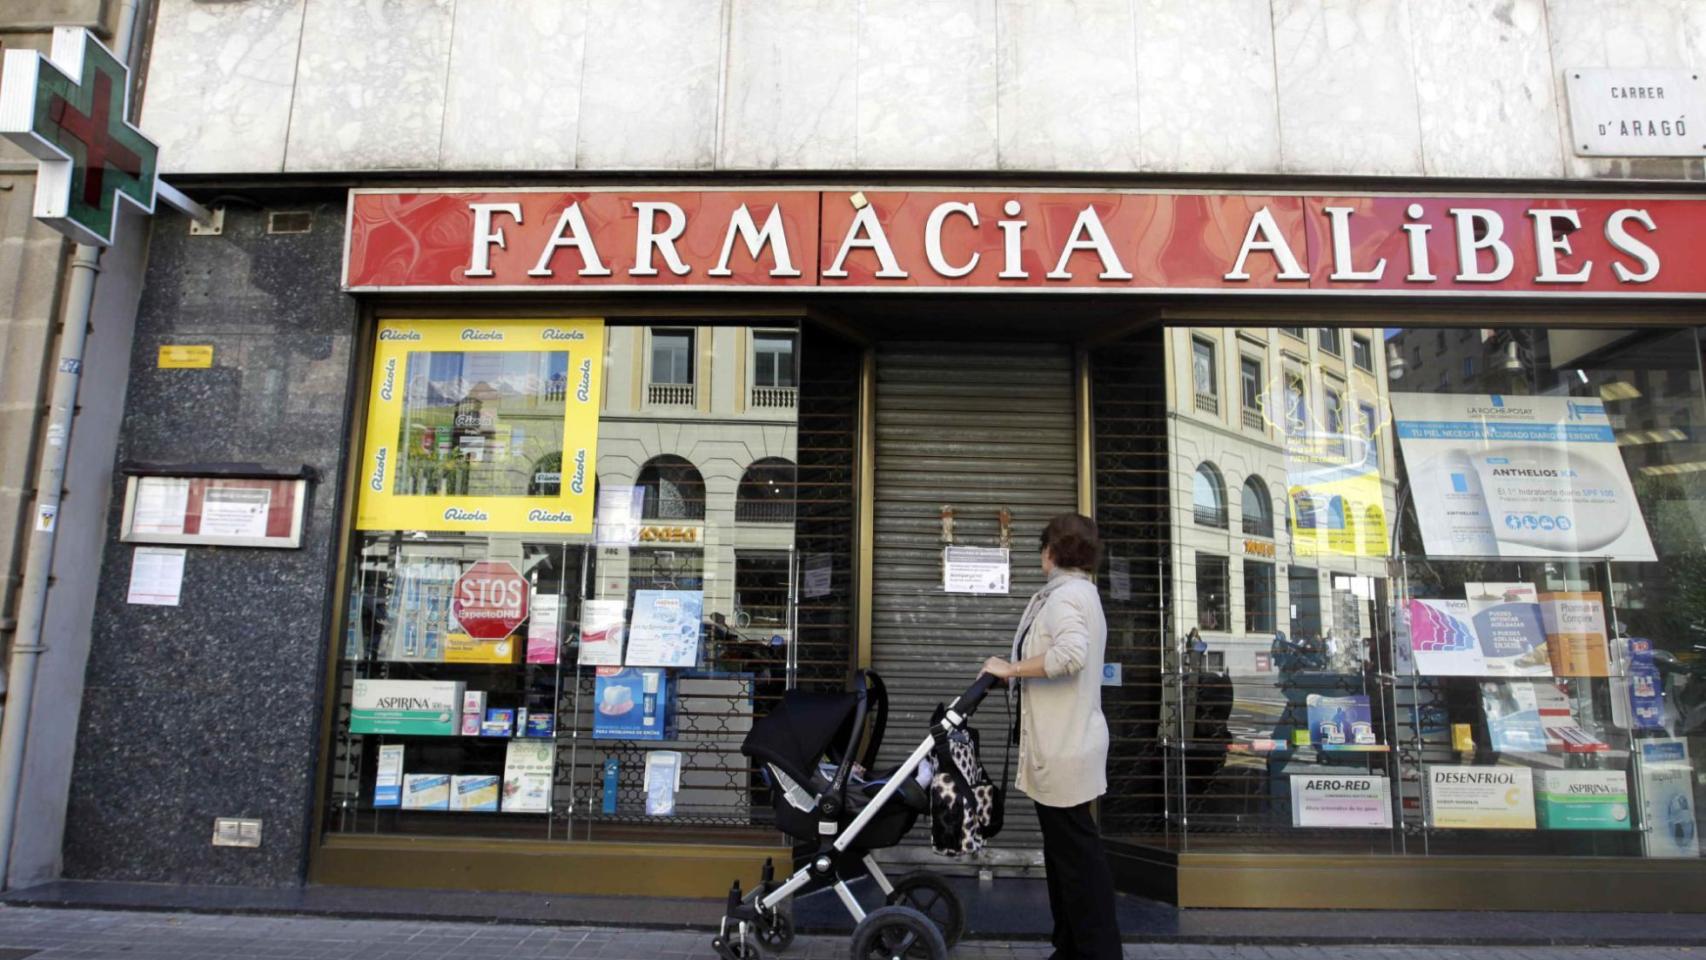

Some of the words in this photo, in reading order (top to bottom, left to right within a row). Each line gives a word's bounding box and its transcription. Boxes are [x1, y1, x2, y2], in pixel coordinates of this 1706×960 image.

[1611, 87, 1664, 99] CARRER
[1598, 115, 1686, 136] D'ARAGÓ
[379, 329, 421, 341] Ricola
[461, 329, 503, 341] Ricola
[542, 329, 584, 341] Ricola
[381, 358, 396, 401] Ricola
[577, 359, 591, 402] Ricola
[372, 447, 387, 491] Ricola
[572, 450, 585, 494] Ricola
[1492, 468, 1558, 478] ANTHELIOS
[444, 508, 488, 521] Ricola
[528, 509, 572, 523] Ricola
[460, 578, 522, 609] STOS
[376, 696, 430, 710] ASPIRINA
[1305, 779, 1371, 791] AERO-RED
[1568, 783, 1610, 795] ASPIRINA
